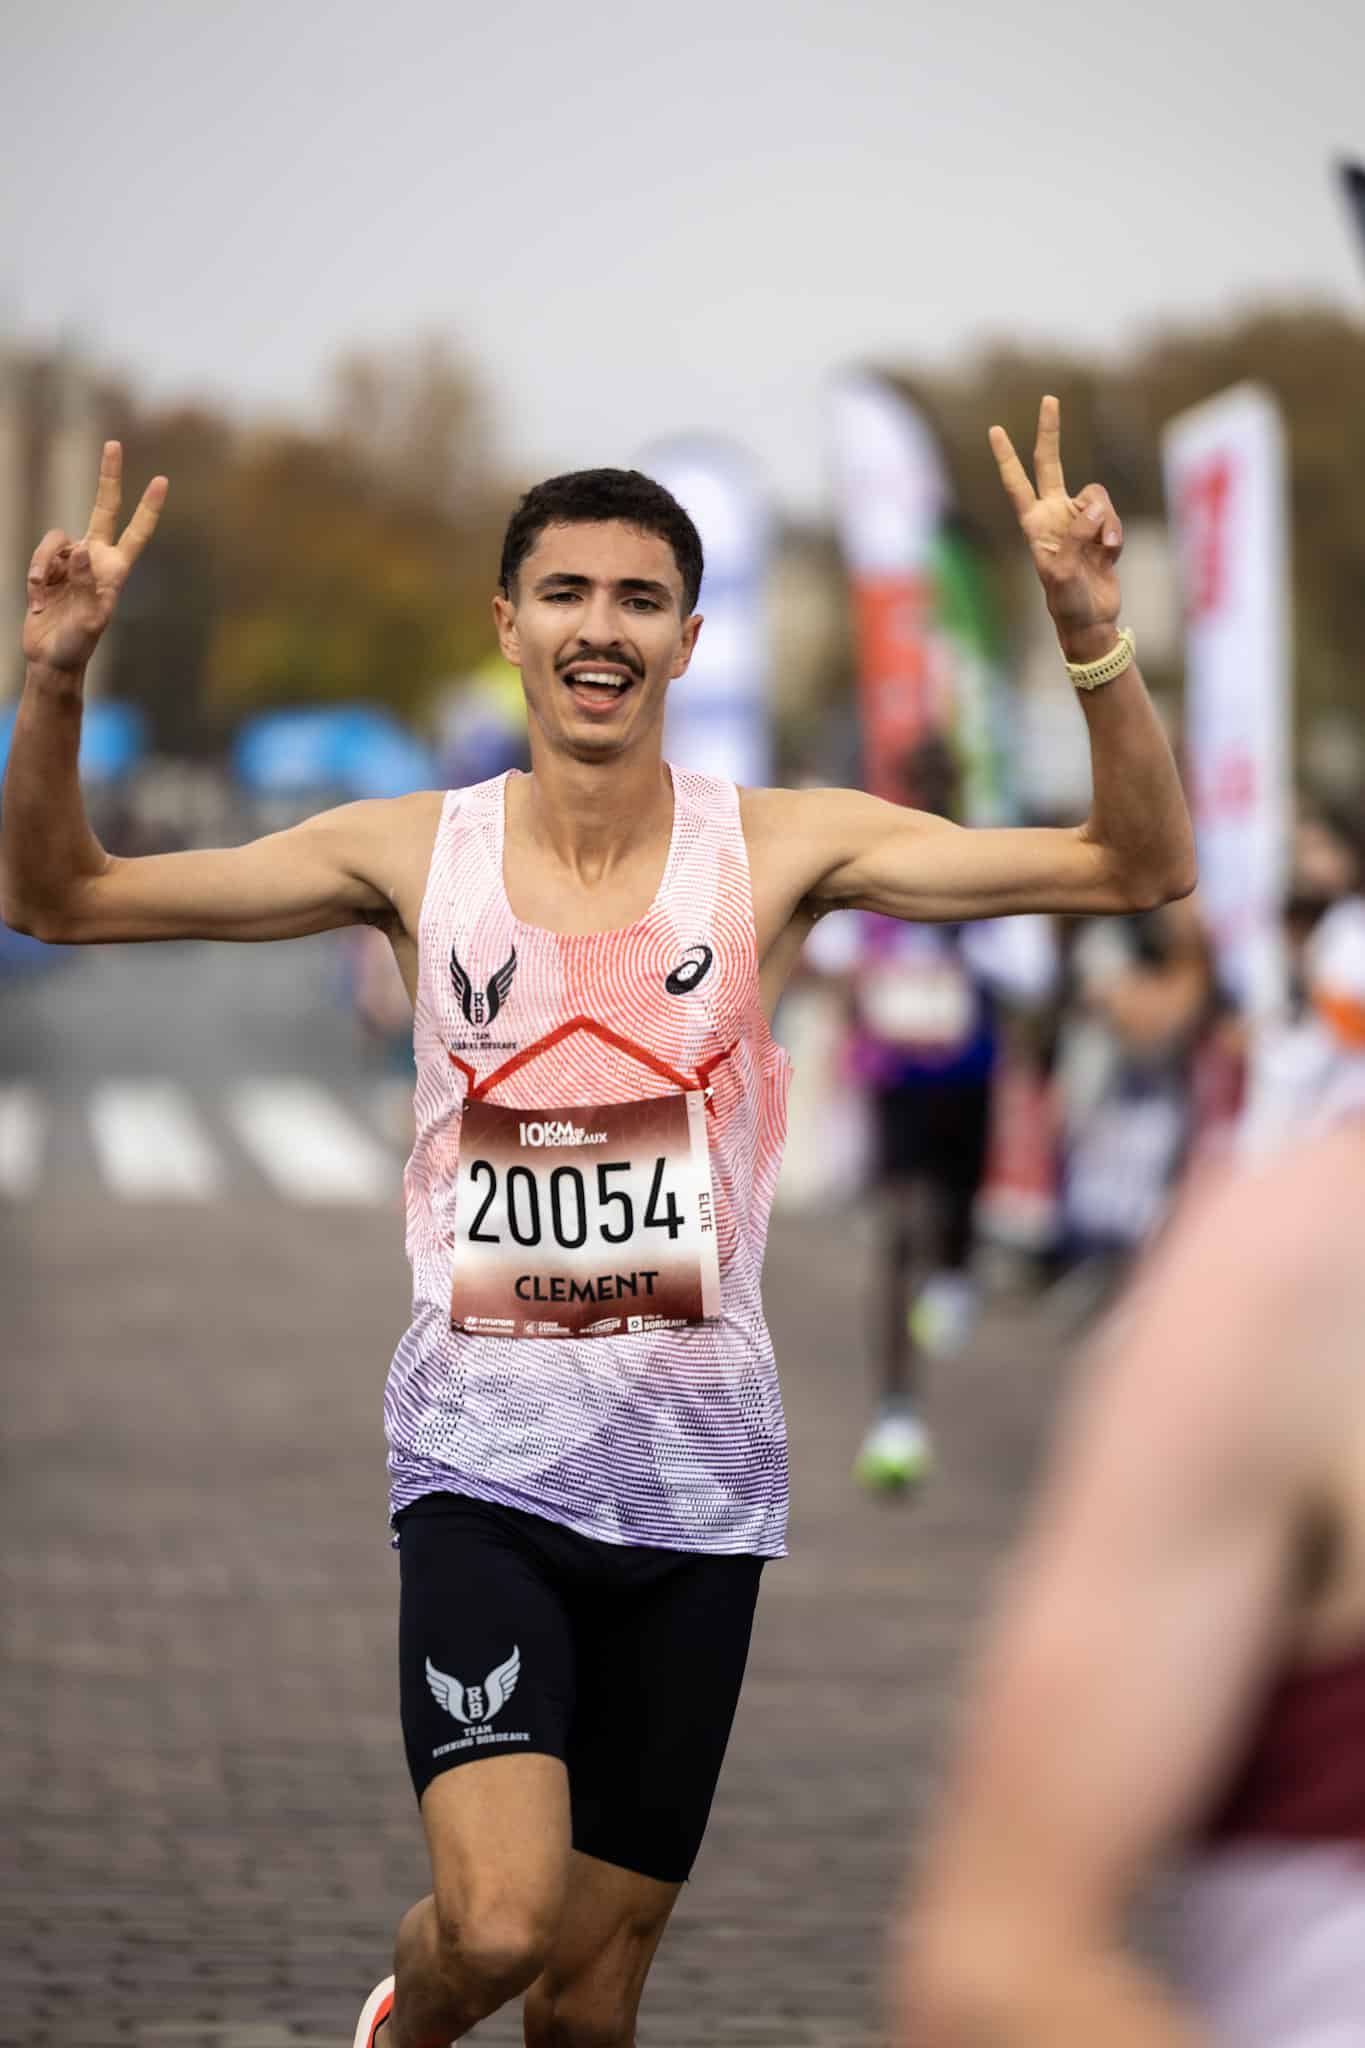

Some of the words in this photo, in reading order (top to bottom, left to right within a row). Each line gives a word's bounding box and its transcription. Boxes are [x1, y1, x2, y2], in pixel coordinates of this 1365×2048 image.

[544, 1131, 608, 1148] BORDEAUX
[468, 1157, 685, 1249] 20054
[698, 1192, 713, 1233] ELITE
[514, 1271, 659, 1303] CLEMENT
[643, 1318, 688, 1330] BORDEAUX
[464, 1725, 492, 1736] TEAM
